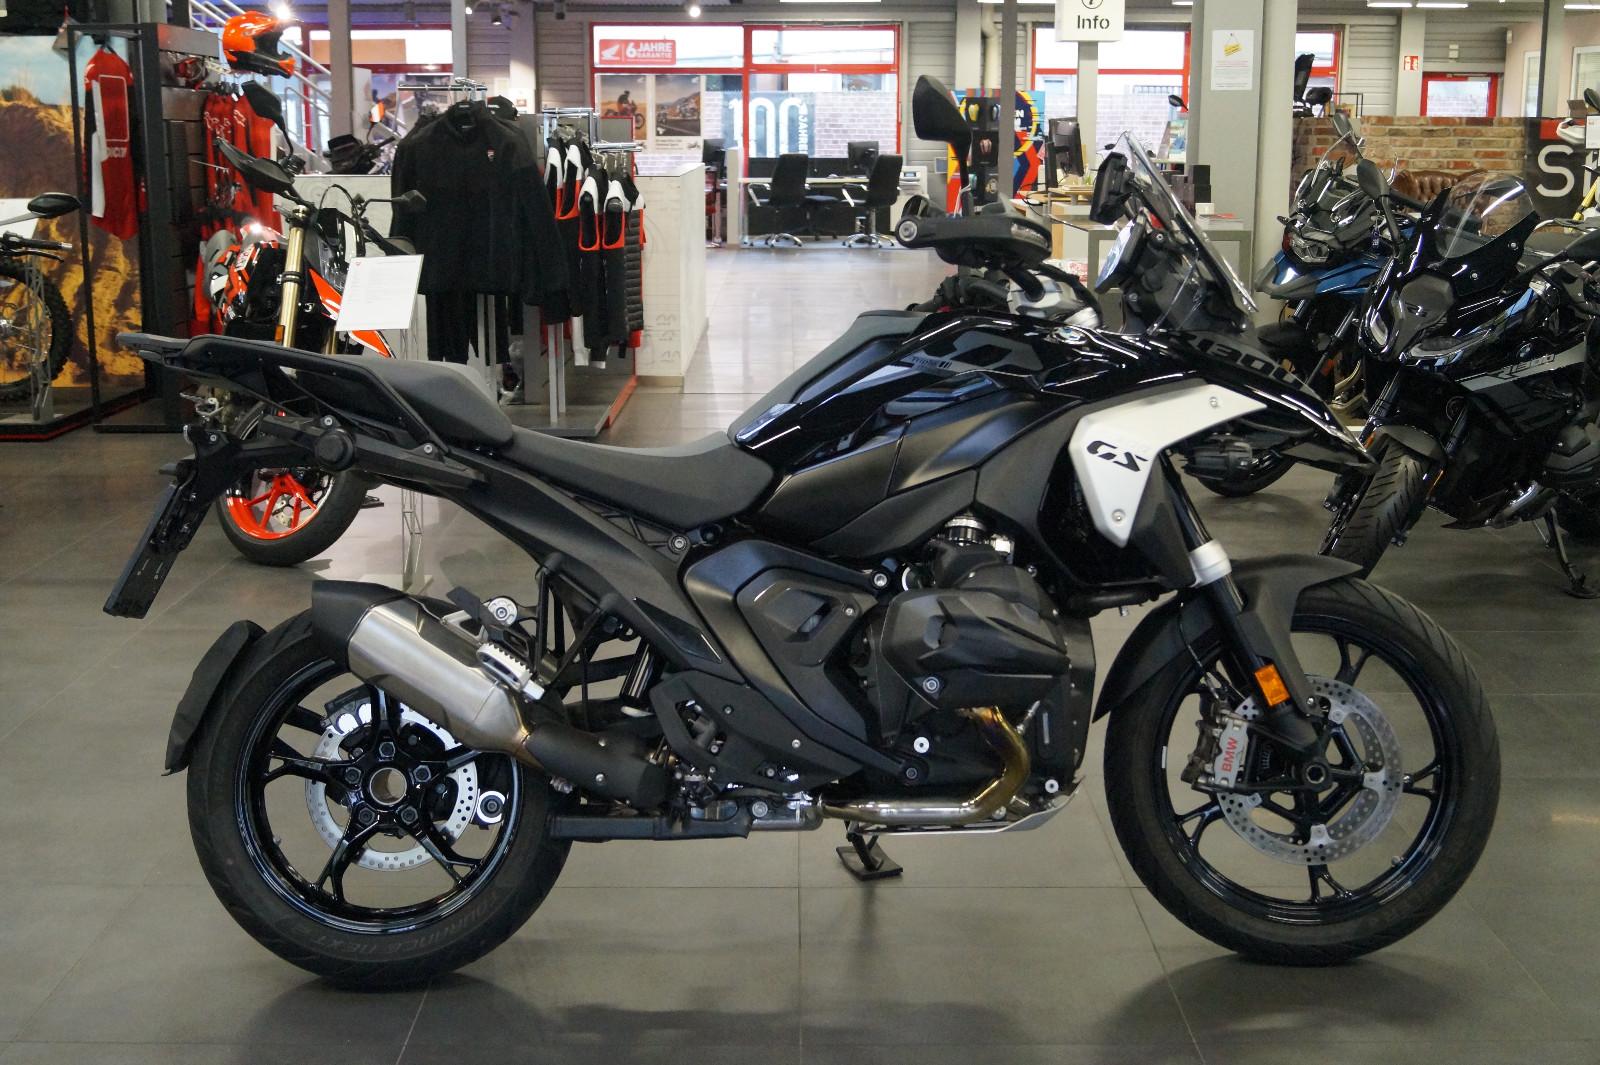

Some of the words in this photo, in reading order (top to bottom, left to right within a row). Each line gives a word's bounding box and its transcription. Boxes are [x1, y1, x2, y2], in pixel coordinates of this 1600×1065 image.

[1077, 15, 1110, 30] Info
[625, 42, 637, 58] 6
[640, 42, 673, 52] JAHRE
[1086, 440, 1148, 472] GS
[1221, 736, 1238, 772] BMW
